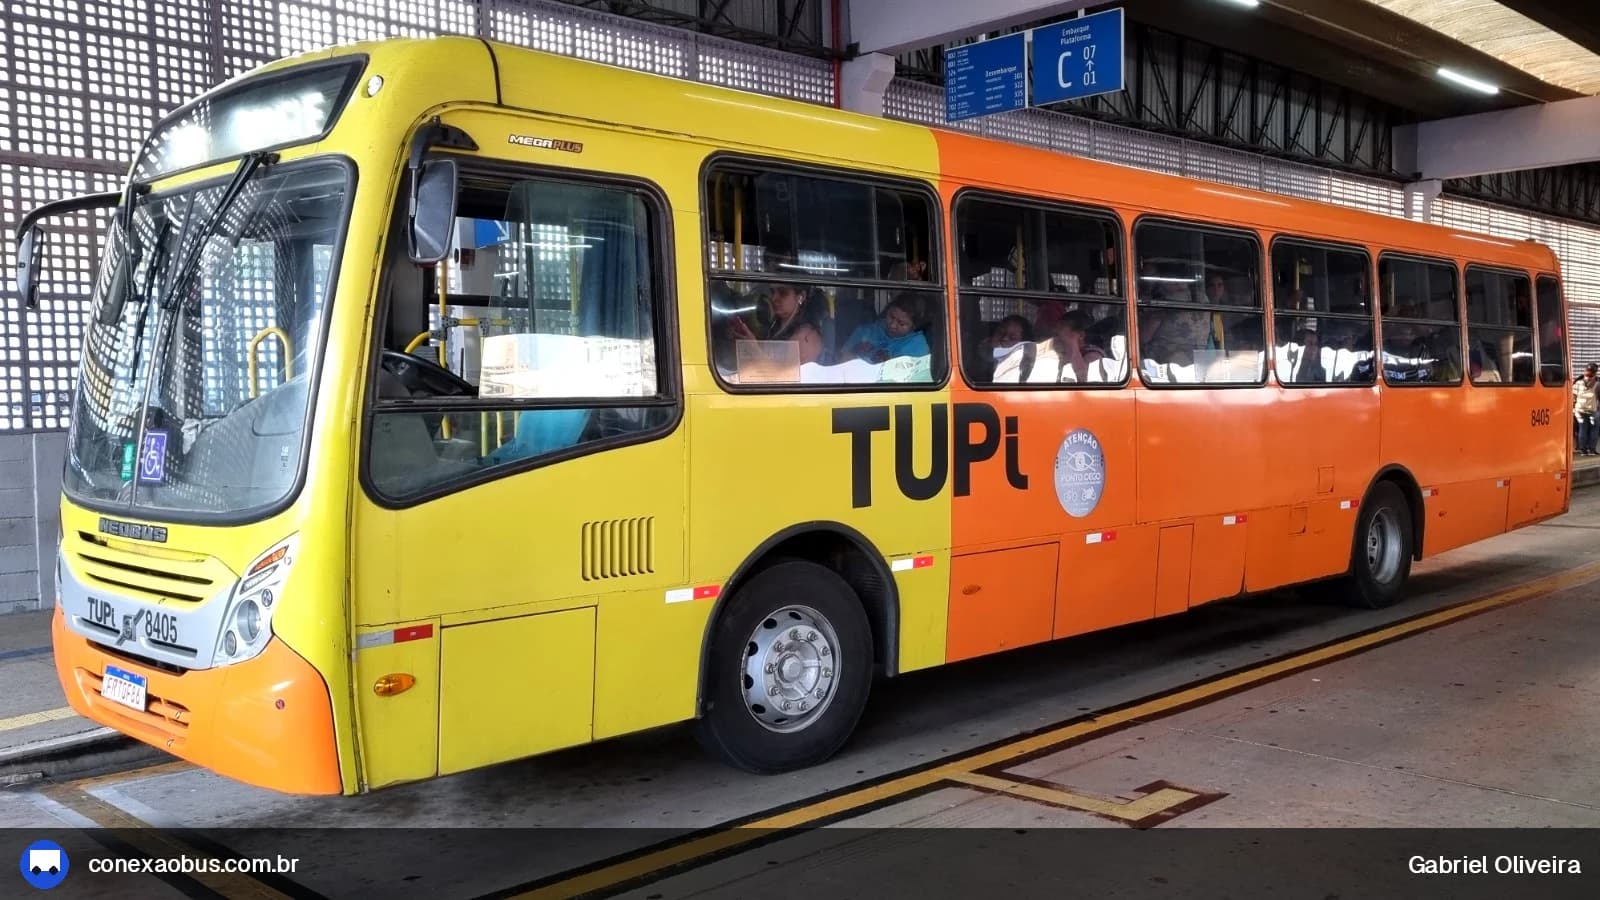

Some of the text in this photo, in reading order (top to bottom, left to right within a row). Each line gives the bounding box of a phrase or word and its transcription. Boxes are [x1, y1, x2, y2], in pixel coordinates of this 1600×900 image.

[1060, 33, 1092, 46] Plataforma
[1062, 25, 1090, 37] Embarque
[1083, 44, 1096, 60] 07
[1058, 51, 1072, 89] C
[1083, 71, 1096, 86] 01
[1531, 408, 1550, 427] 8405
[99, 517, 168, 543] NEOBUS
[145, 609, 178, 643] 8405
